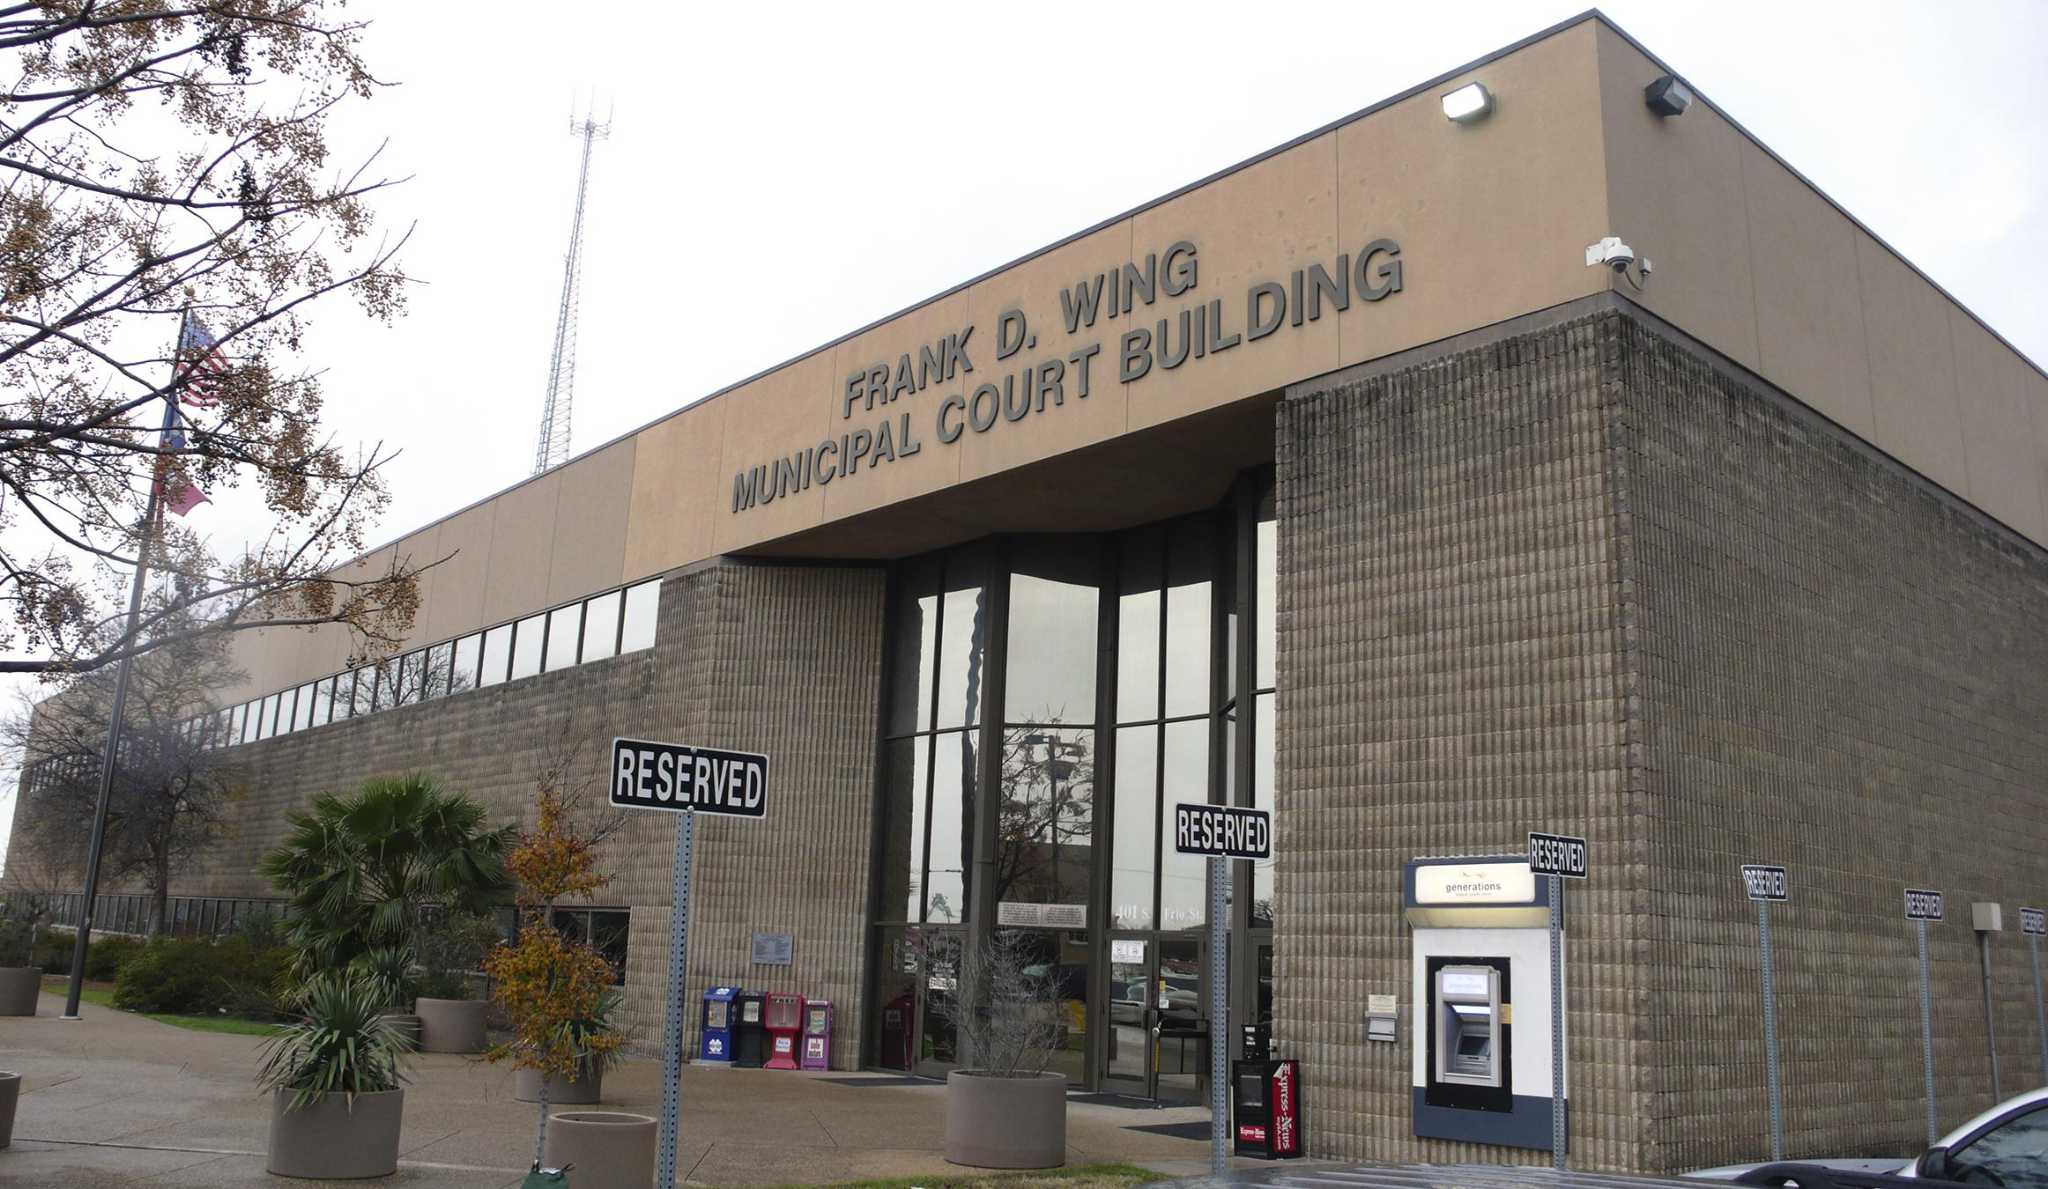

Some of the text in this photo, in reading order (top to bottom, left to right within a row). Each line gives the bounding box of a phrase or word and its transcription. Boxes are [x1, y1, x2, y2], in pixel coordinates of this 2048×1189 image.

[843, 239, 1198, 419] FRANK D. WING
[731, 237, 1403, 514] MUNICIPAL COURT BUILDING
[616, 748, 762, 809] RESERVED
[1178, 809, 1268, 853] RESERVED
[1531, 838, 1585, 872] RESERVED
[1445, 882, 1502, 894] generations
[1744, 869, 1785, 896] RESERVED
[1906, 893, 1942, 917] RESERVED
[1278, 1062, 1293, 1150] Express-News
